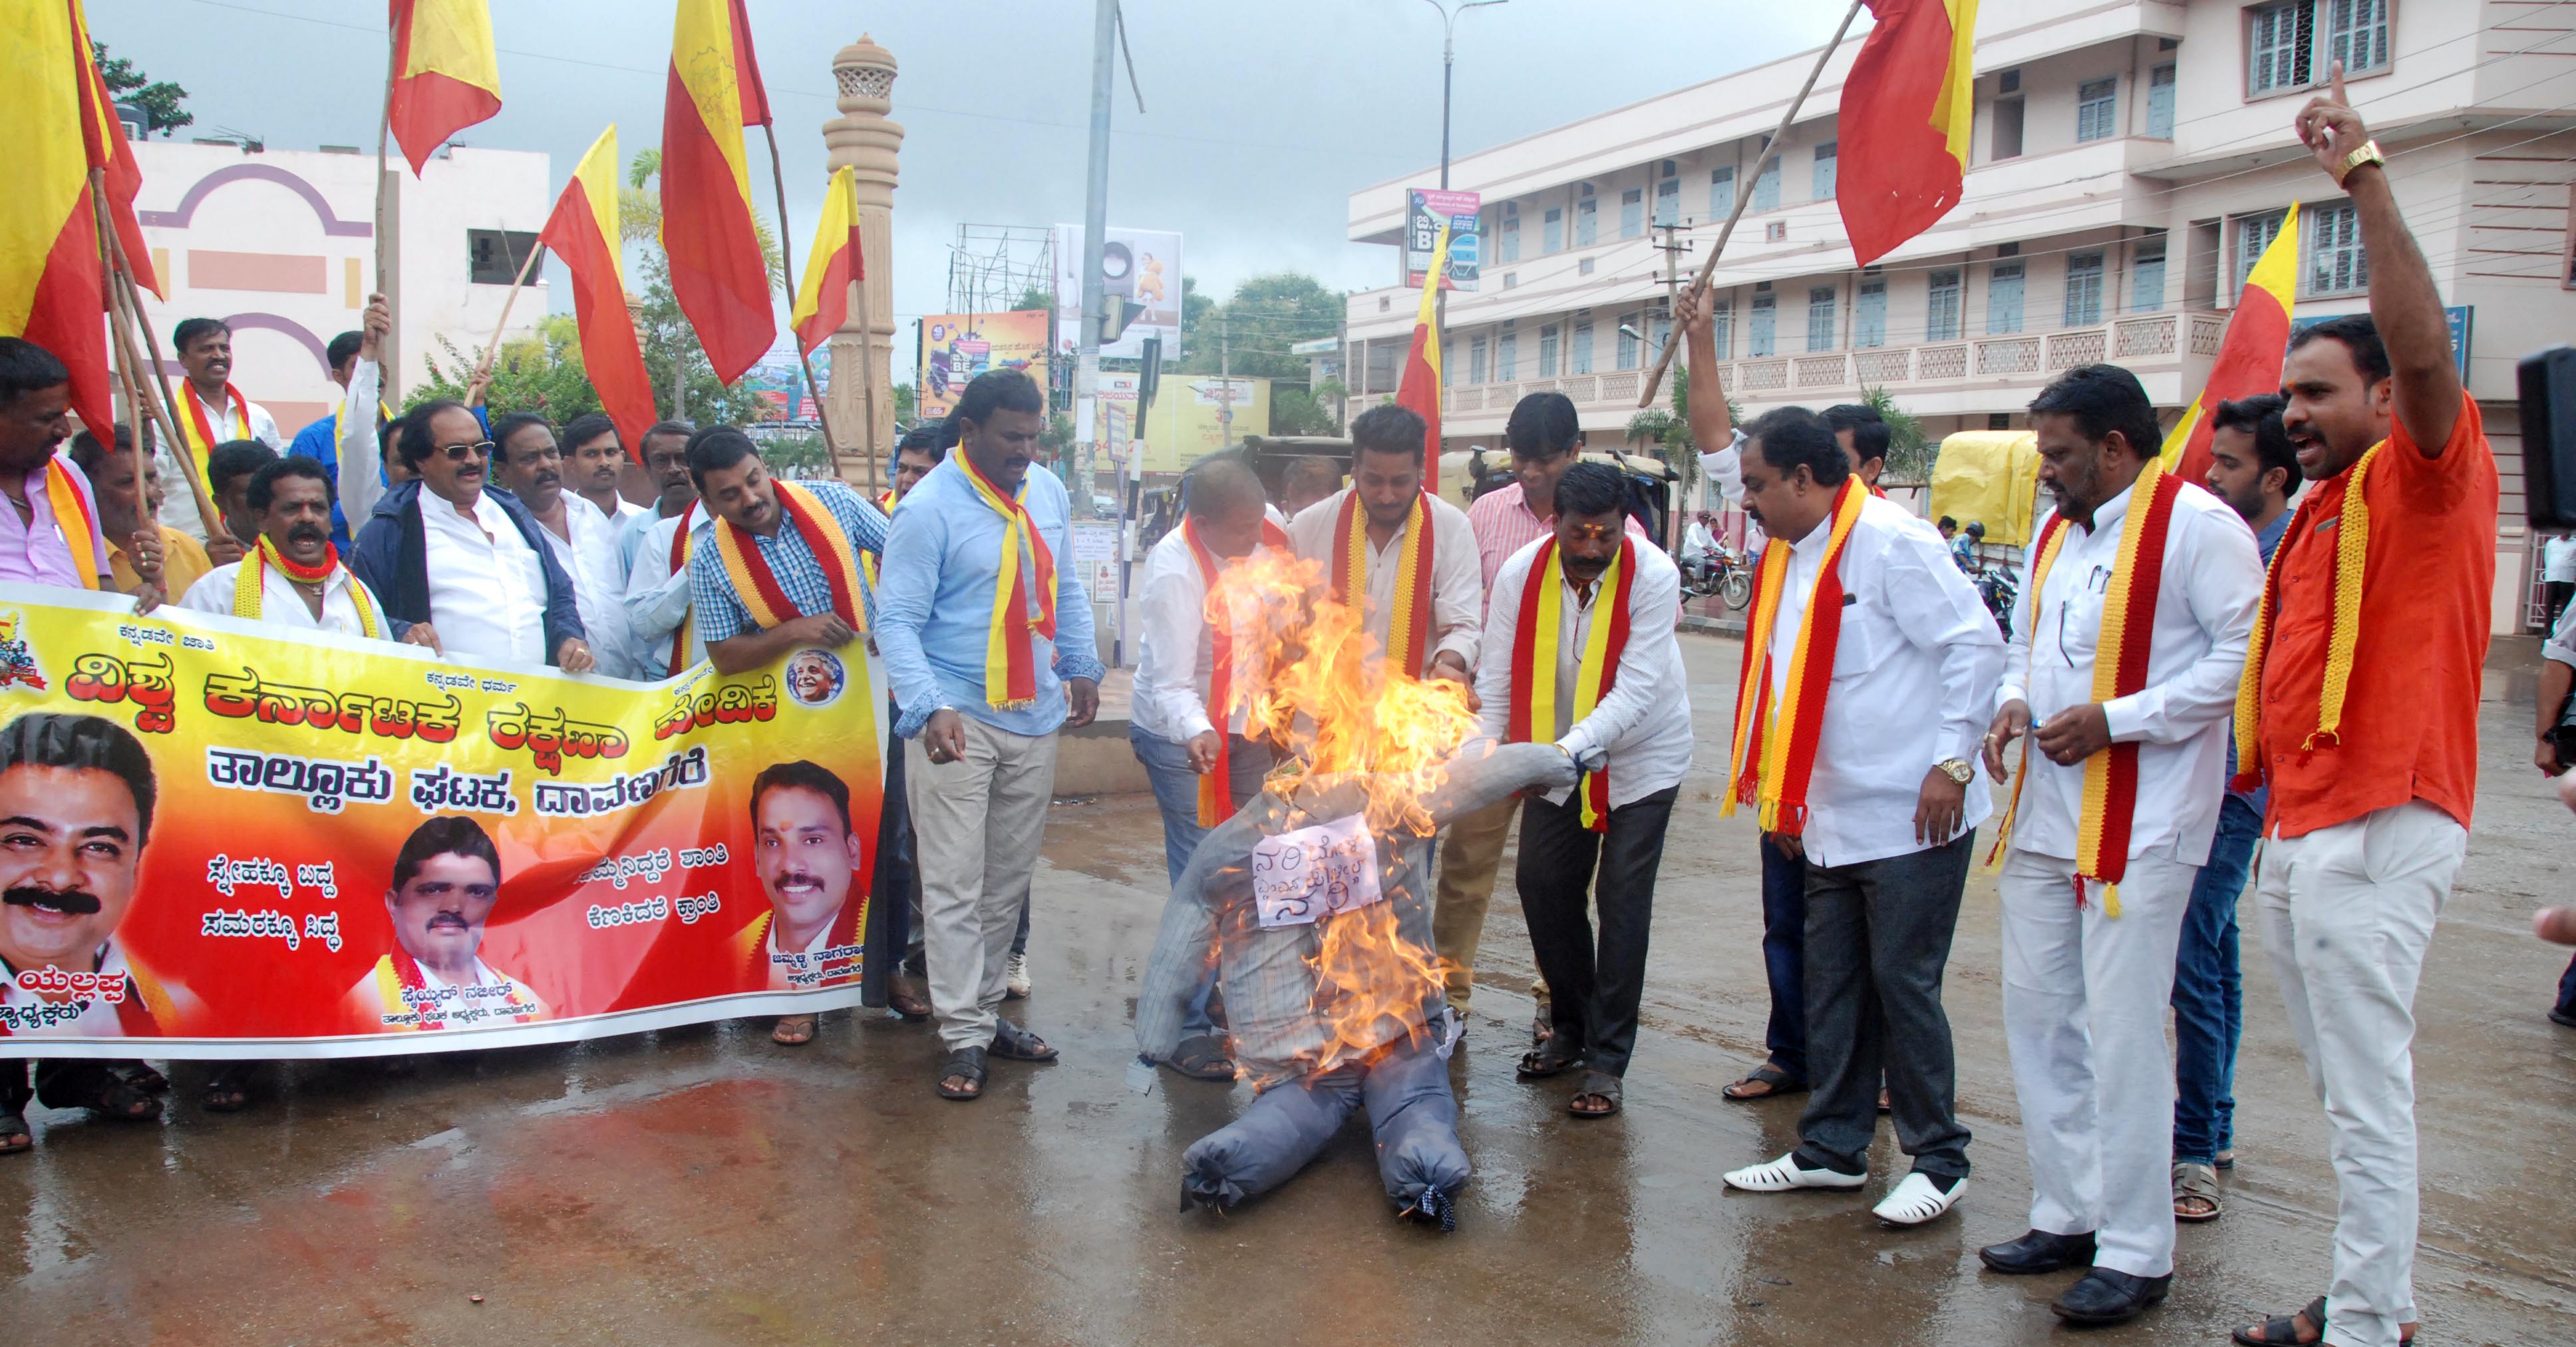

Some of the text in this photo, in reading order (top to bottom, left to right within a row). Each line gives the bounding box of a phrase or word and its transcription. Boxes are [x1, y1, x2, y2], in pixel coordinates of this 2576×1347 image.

[119, 624, 215, 650] ಕನ್ನಡವೇ ಜಾತಿ
[427, 672, 517, 692] ಕನ್ನಡವೇ ಧರ್ಮ
[66, 652, 778, 777] ವಿಶ್ವ ಕರ್ನಾಟಕ ರಕ್ಷಣಾ ವೇದಿಕೆ
[210, 747, 707, 814] ತಾಲ್ಲೂಕು ಘಟಕ, ದಾವಣಗೆರೆ
[681, 845, 726, 866] ಶಾಂತಿ
[209, 856, 290, 896] ಸ್ನೇಹಕ್ಕೂ
[589, 893, 719, 927] ಕೆಣಕಿದರೆ ಕ್ರಾಂತಿ
[204, 911, 297, 948] ಸಮರಕ್ಕೂ
[18, 966, 126, 1002] ಯಲ್ಲಪ್ಪ
